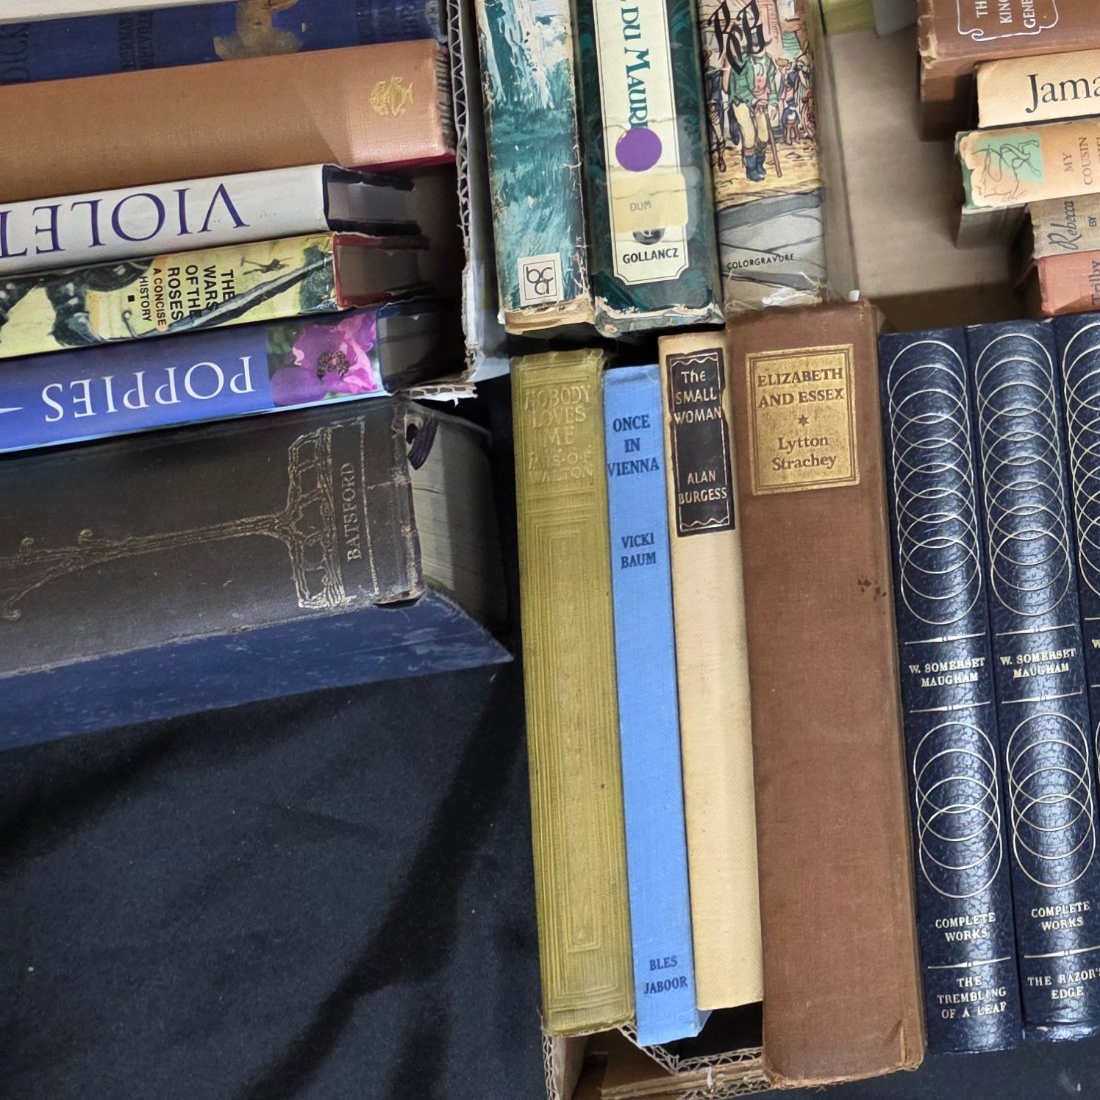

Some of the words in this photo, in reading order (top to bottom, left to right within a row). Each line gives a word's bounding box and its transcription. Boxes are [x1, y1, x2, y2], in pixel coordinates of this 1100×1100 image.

[620, 7, 641, 41] DU
[622, 247, 679, 264] GOLLANCZ
[726, 253, 795, 271] COLORGRAVURE
[139, 276, 152, 322] HISTORY
[167, 266, 184, 322] ROSES
[681, 371, 706, 383] The
[757, 367, 843, 387] ELIZABETH
[42, 356, 255, 422] POPPIES
[675, 389, 717, 405] SMALL
[757, 393, 794, 408] AND
[798, 388, 844, 403] ESSEX
[612, 414, 650, 433] ONCE
[673, 406, 722, 424] WOMAN
[624, 437, 641, 453] IN
[777, 434, 829, 452] Lytton
[607, 458, 660, 478] VIENNA
[772, 454, 837, 473] Strachey
[687, 469, 716, 484] ALAN
[678, 487, 727, 505] BURGESS
[341, 462, 362, 562] BATSFORD
[621, 533, 654, 549] VICKI
[620, 552, 656, 569] BAUM
[649, 955, 677, 972] BLES
[643, 974, 688, 996] JABOOR
